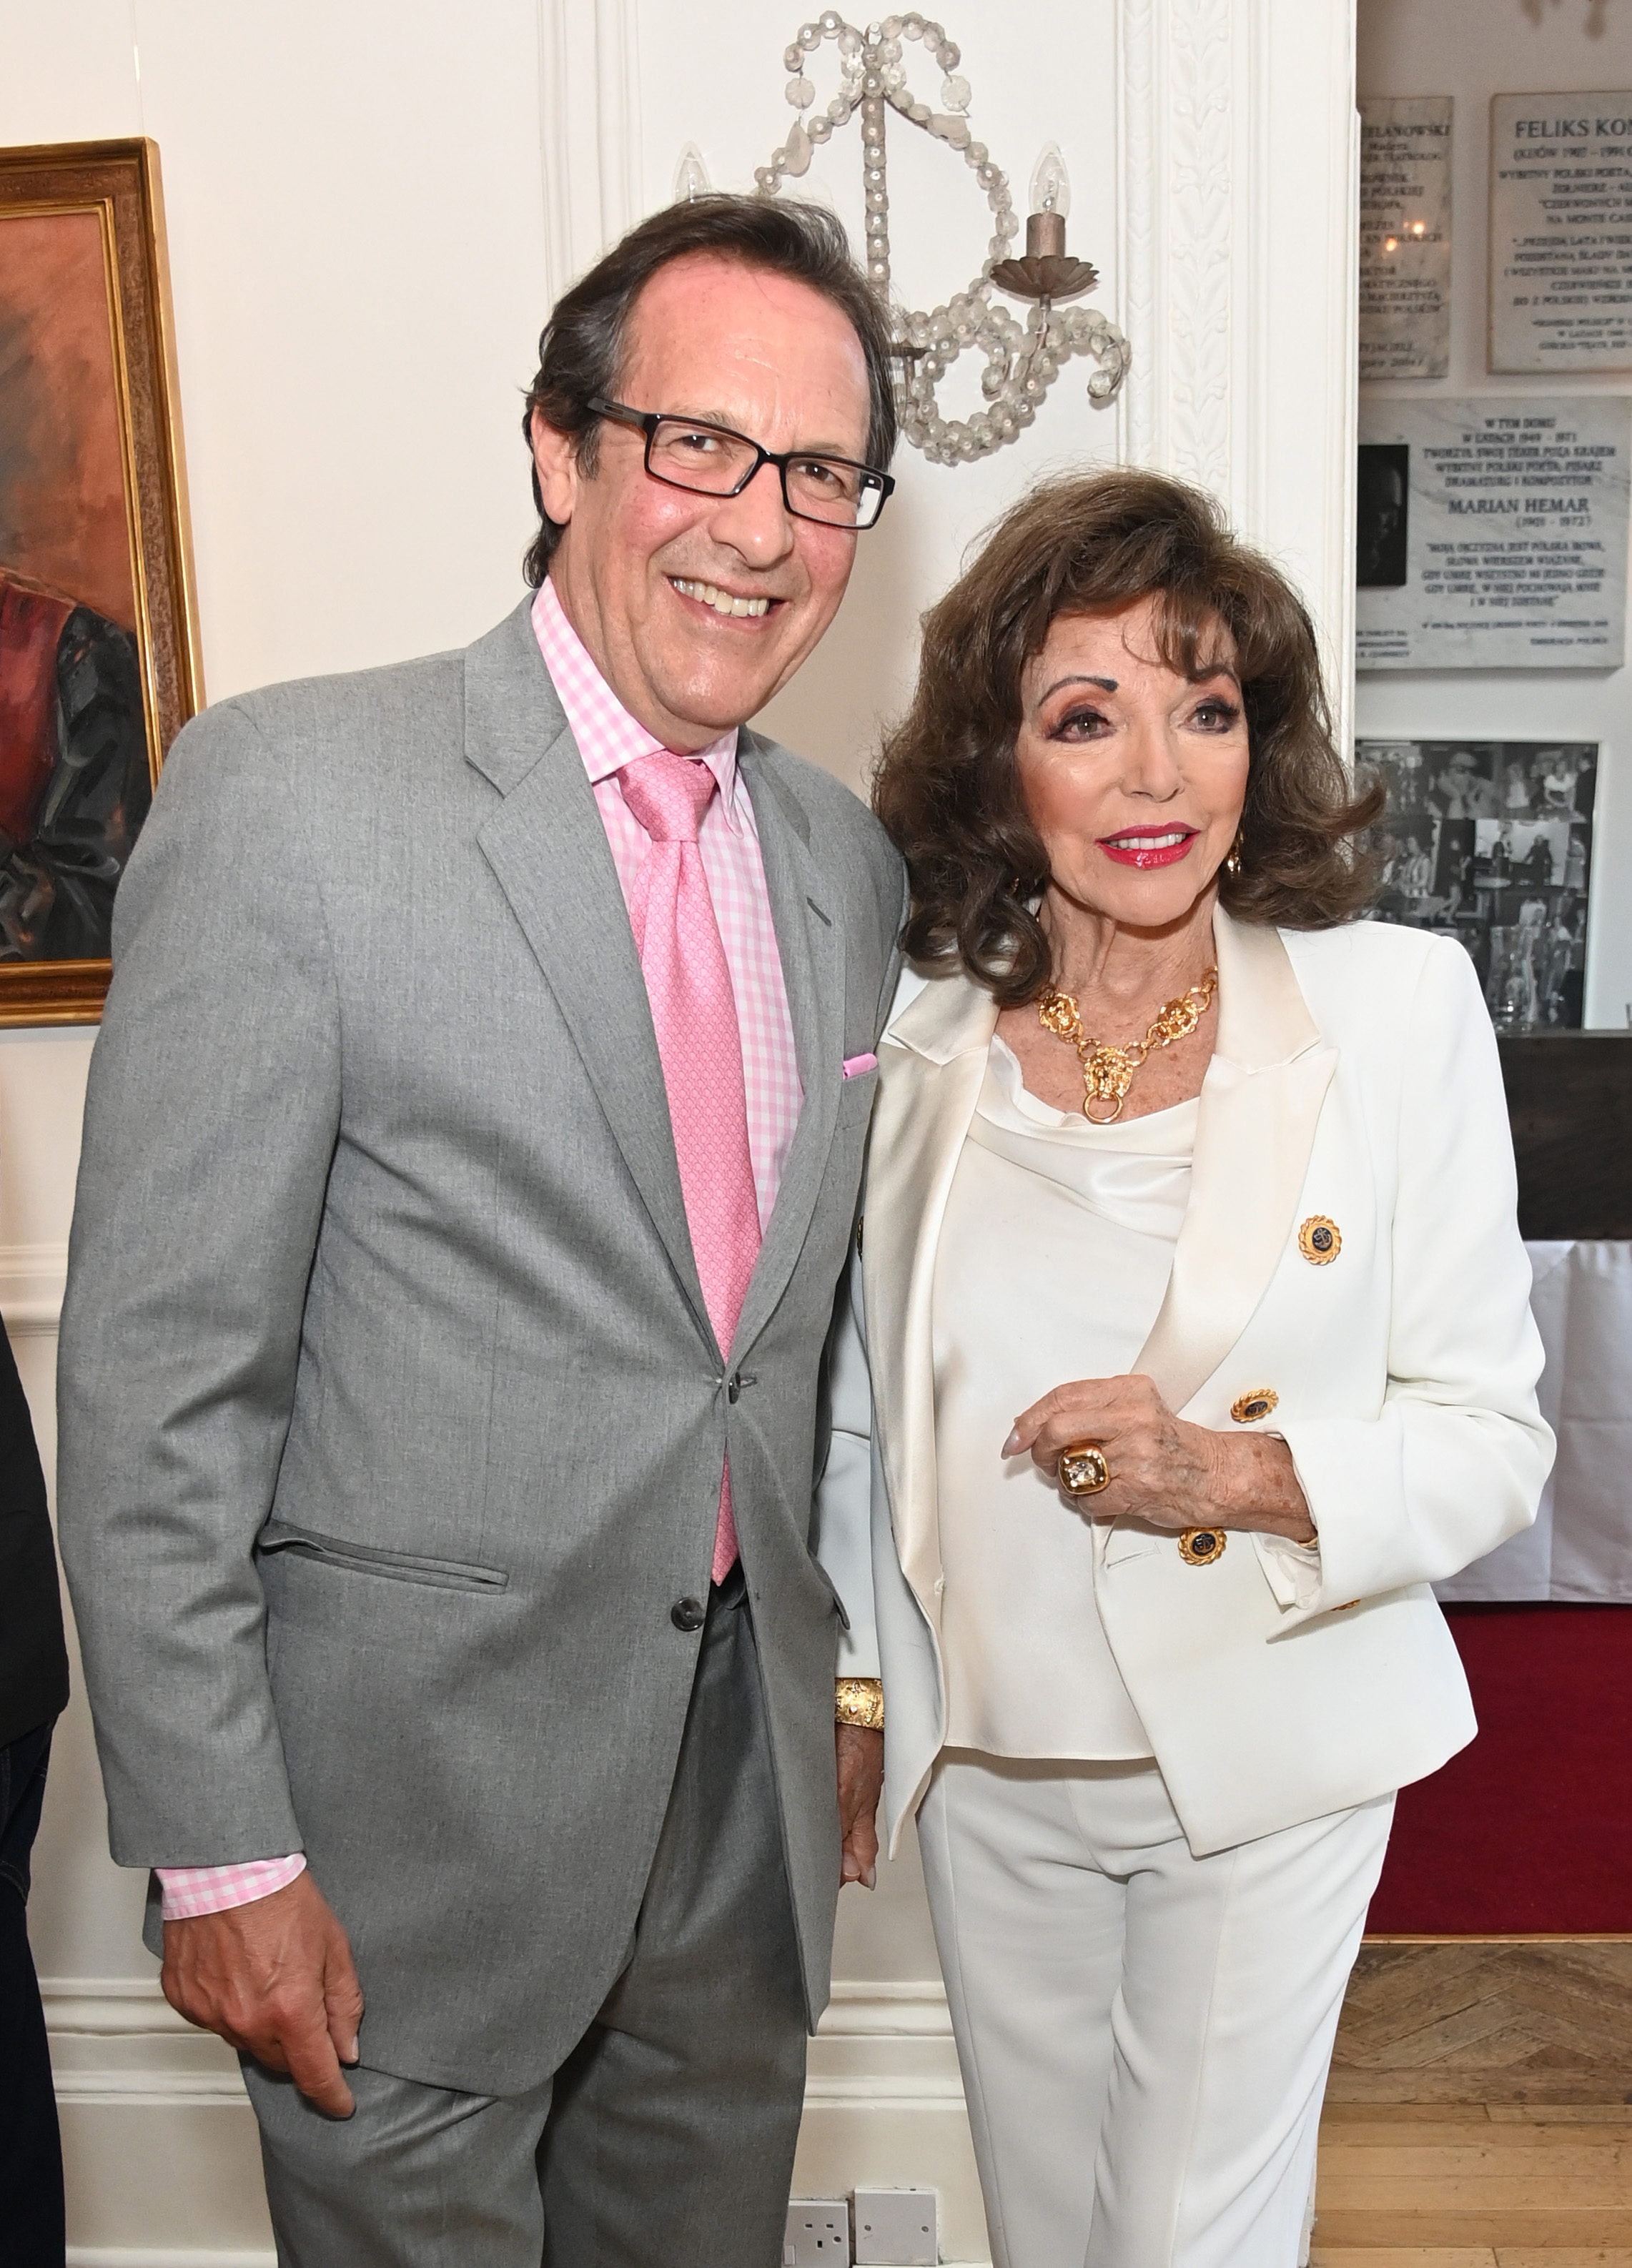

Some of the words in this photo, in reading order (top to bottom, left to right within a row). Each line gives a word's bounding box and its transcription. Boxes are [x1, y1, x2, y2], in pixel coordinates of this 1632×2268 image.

[1515, 119, 1589, 139] FELIKS
[1448, 498, 1520, 514] MARIAN
[1525, 497, 1589, 513] HEMAR
